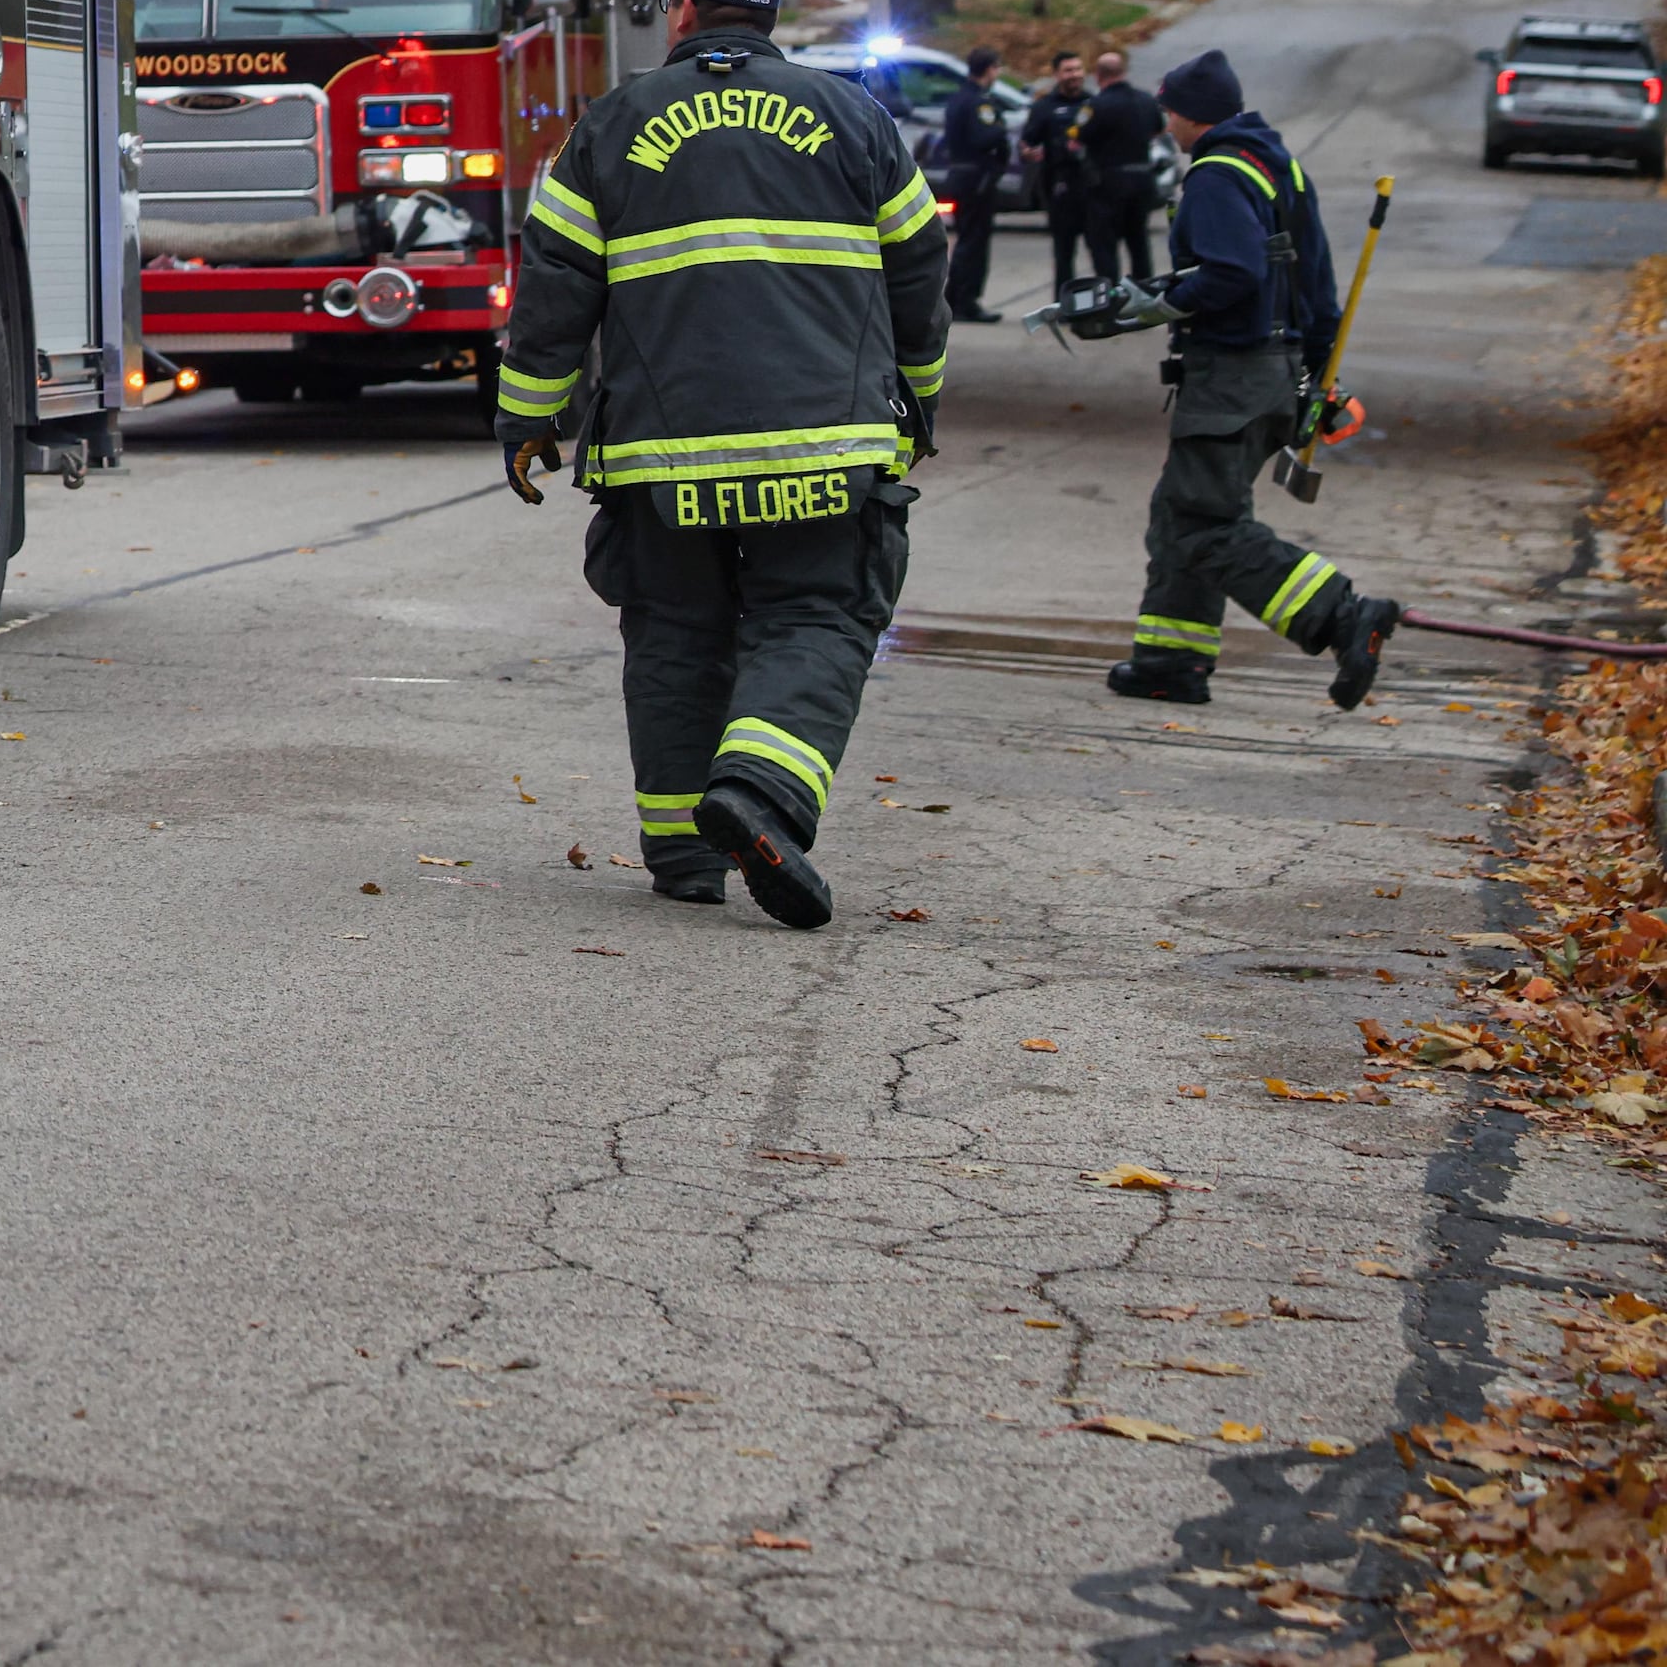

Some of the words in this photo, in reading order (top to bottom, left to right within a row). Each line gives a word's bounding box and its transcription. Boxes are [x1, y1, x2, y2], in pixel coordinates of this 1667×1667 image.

[134, 51, 289, 77] WOODSTOCK
[626, 88, 834, 173] WOODSTOCK
[675, 483, 708, 526] B.
[716, 472, 849, 525] FLORES
